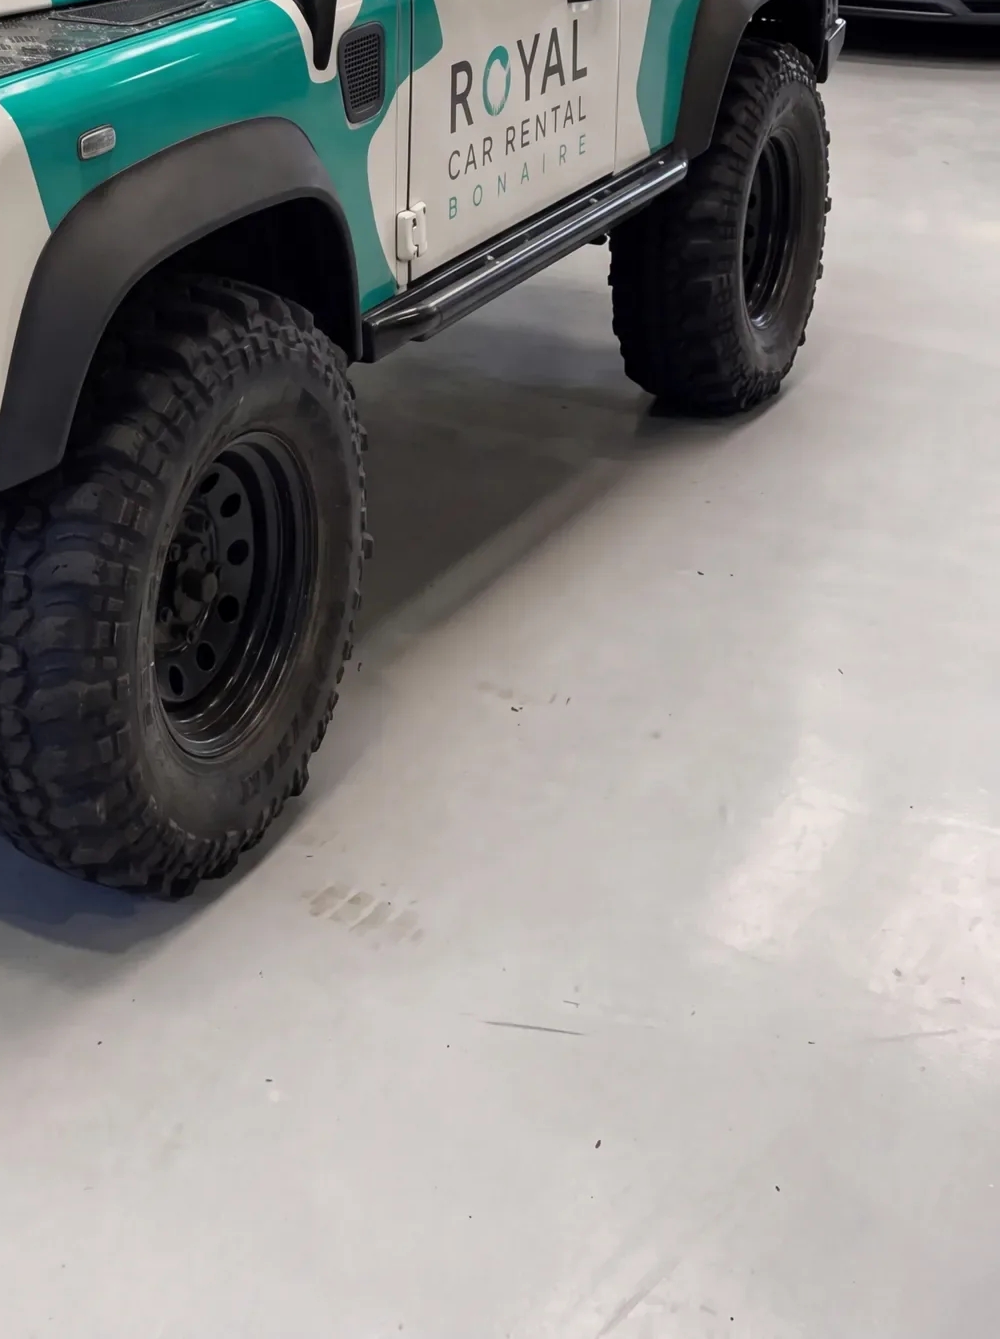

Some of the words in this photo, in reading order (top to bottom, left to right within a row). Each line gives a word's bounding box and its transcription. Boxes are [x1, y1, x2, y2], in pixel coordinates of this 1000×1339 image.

[450, 19, 588, 134] ROYAL
[448, 136, 493, 181] CAR
[505, 95, 587, 156] RENTAL
[449, 134, 586, 220] BONAIRE
